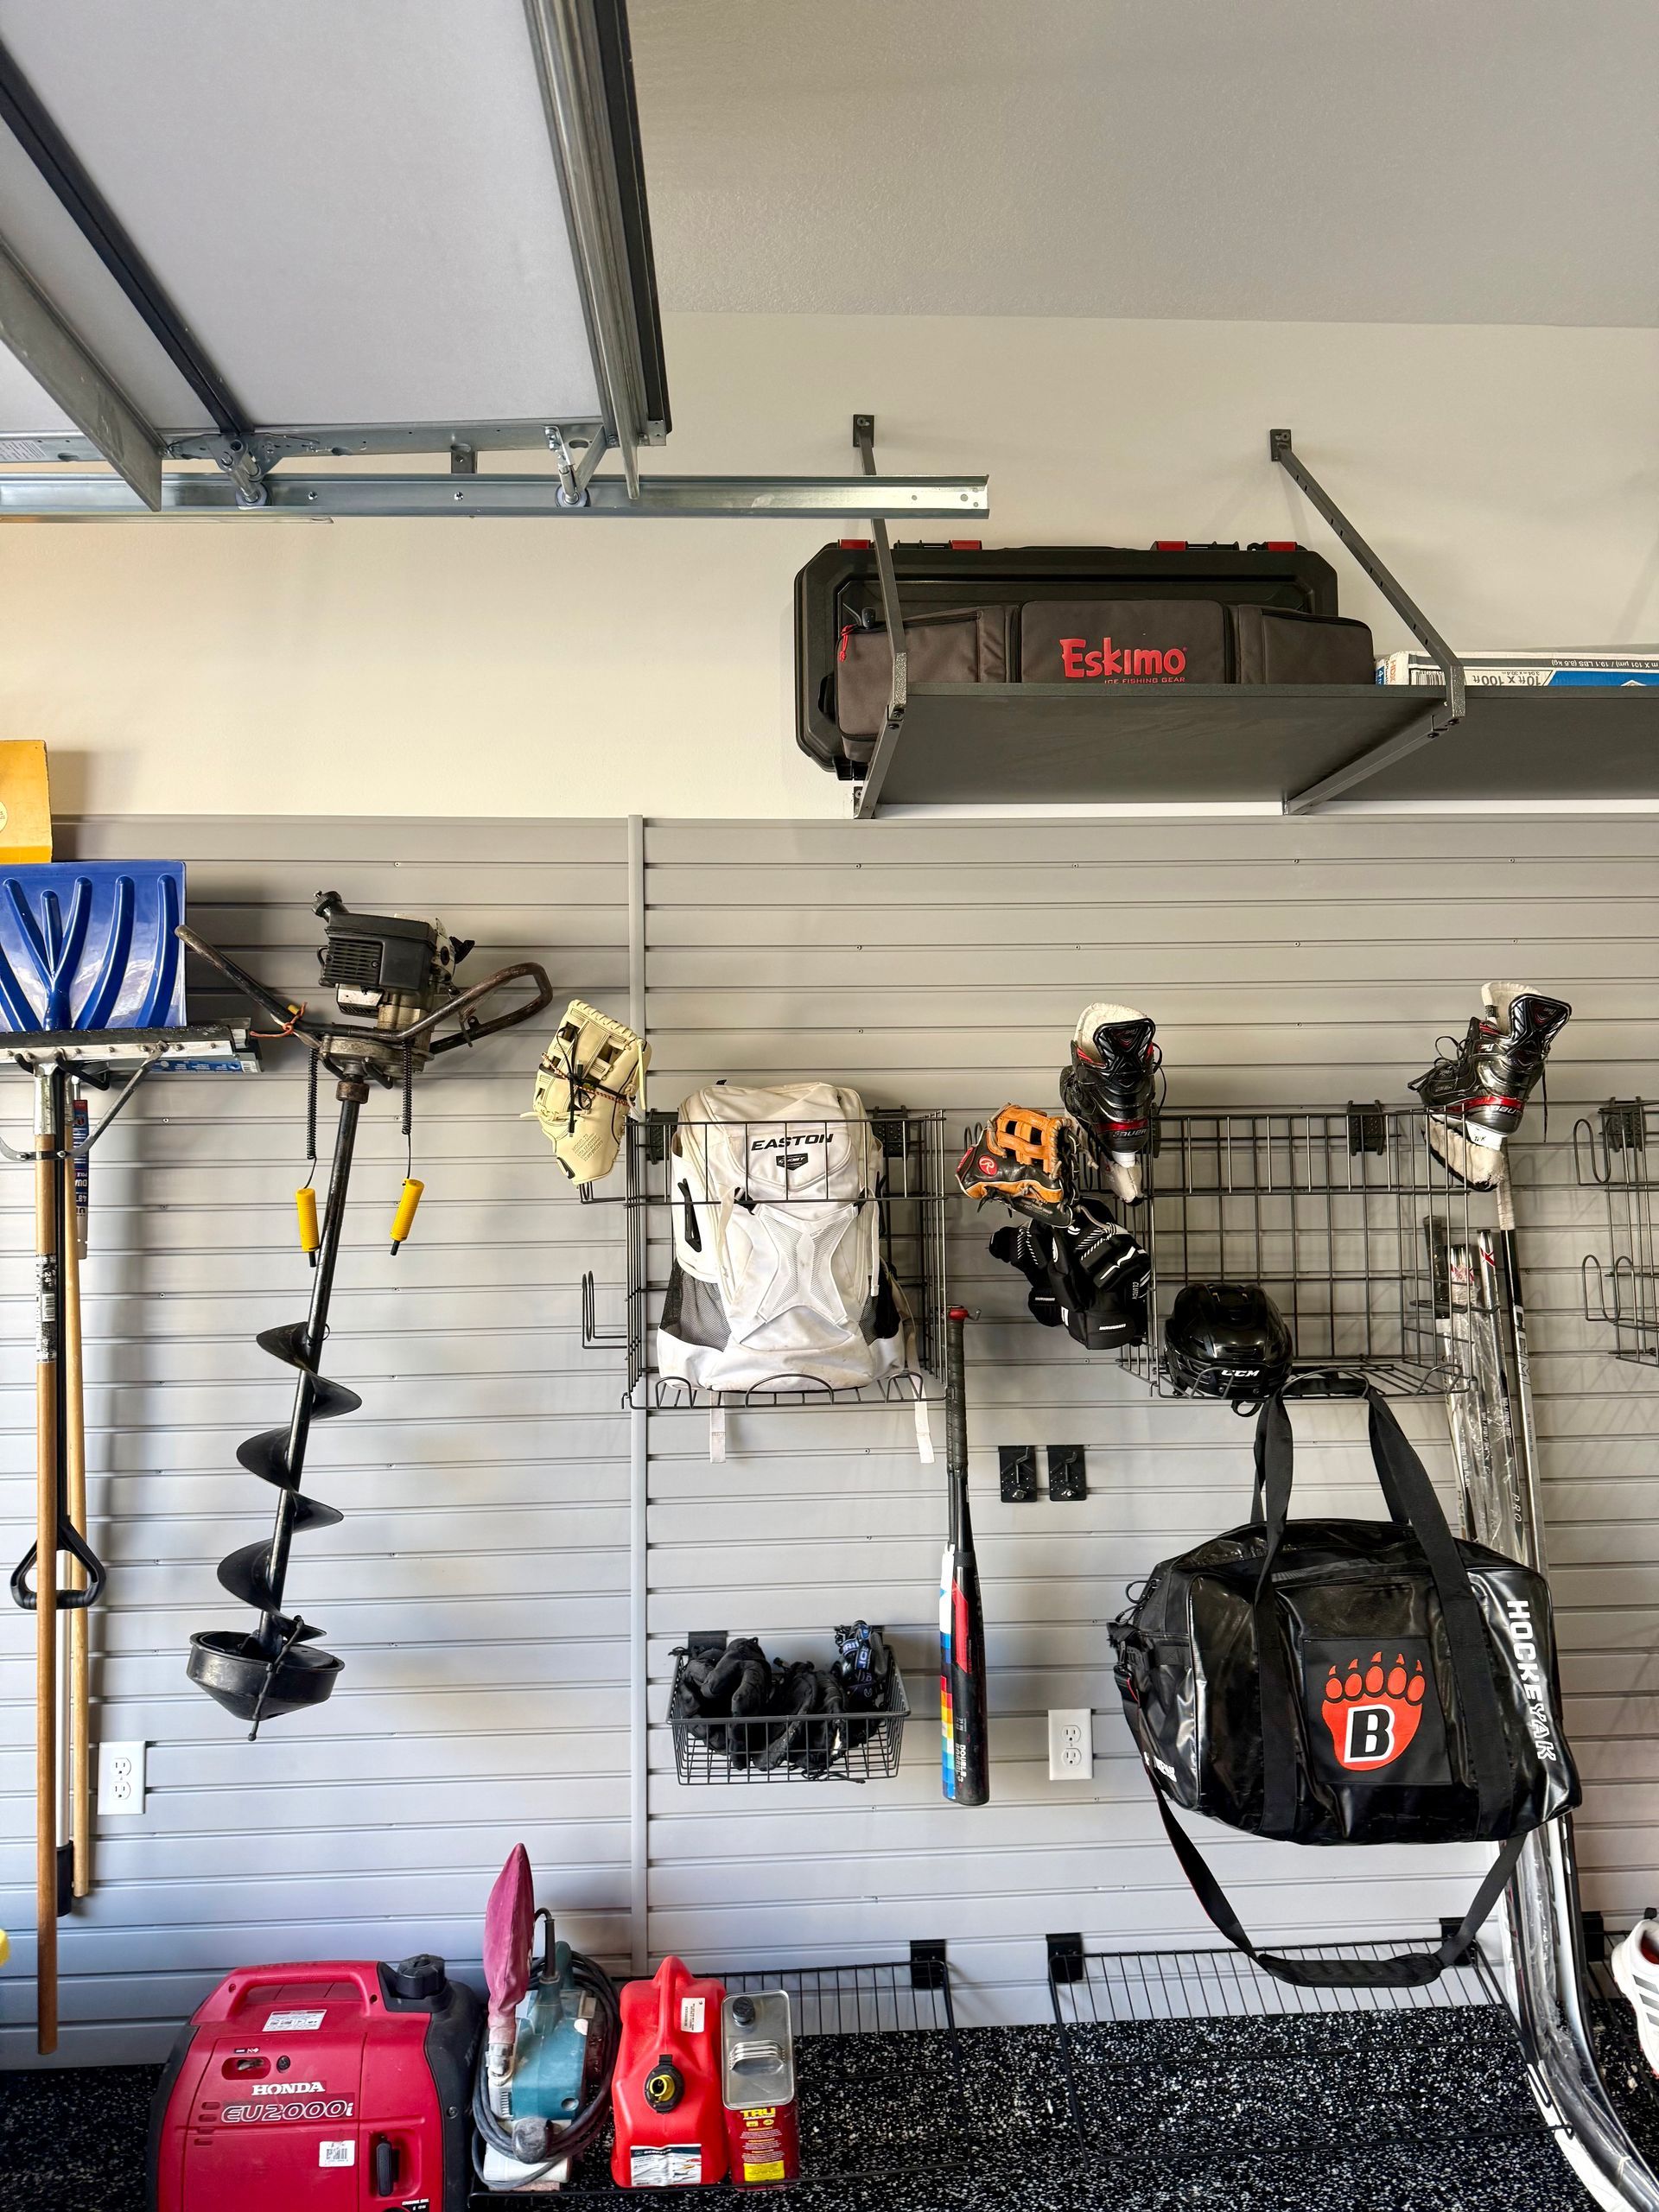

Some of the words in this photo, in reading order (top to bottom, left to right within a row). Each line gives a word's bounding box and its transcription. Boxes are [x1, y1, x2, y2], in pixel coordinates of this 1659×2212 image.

[1059, 637, 1186, 678] Eskimo
[751, 1133, 834, 1152] EASTON
[1511, 1492, 1522, 1522] PRO
[1506, 1600, 1557, 1761] HOCKEYAK
[1344, 1704, 1395, 1764] B
[251, 2082, 326, 2096] HONDA
[220, 2100, 354, 2124] EU2000i
